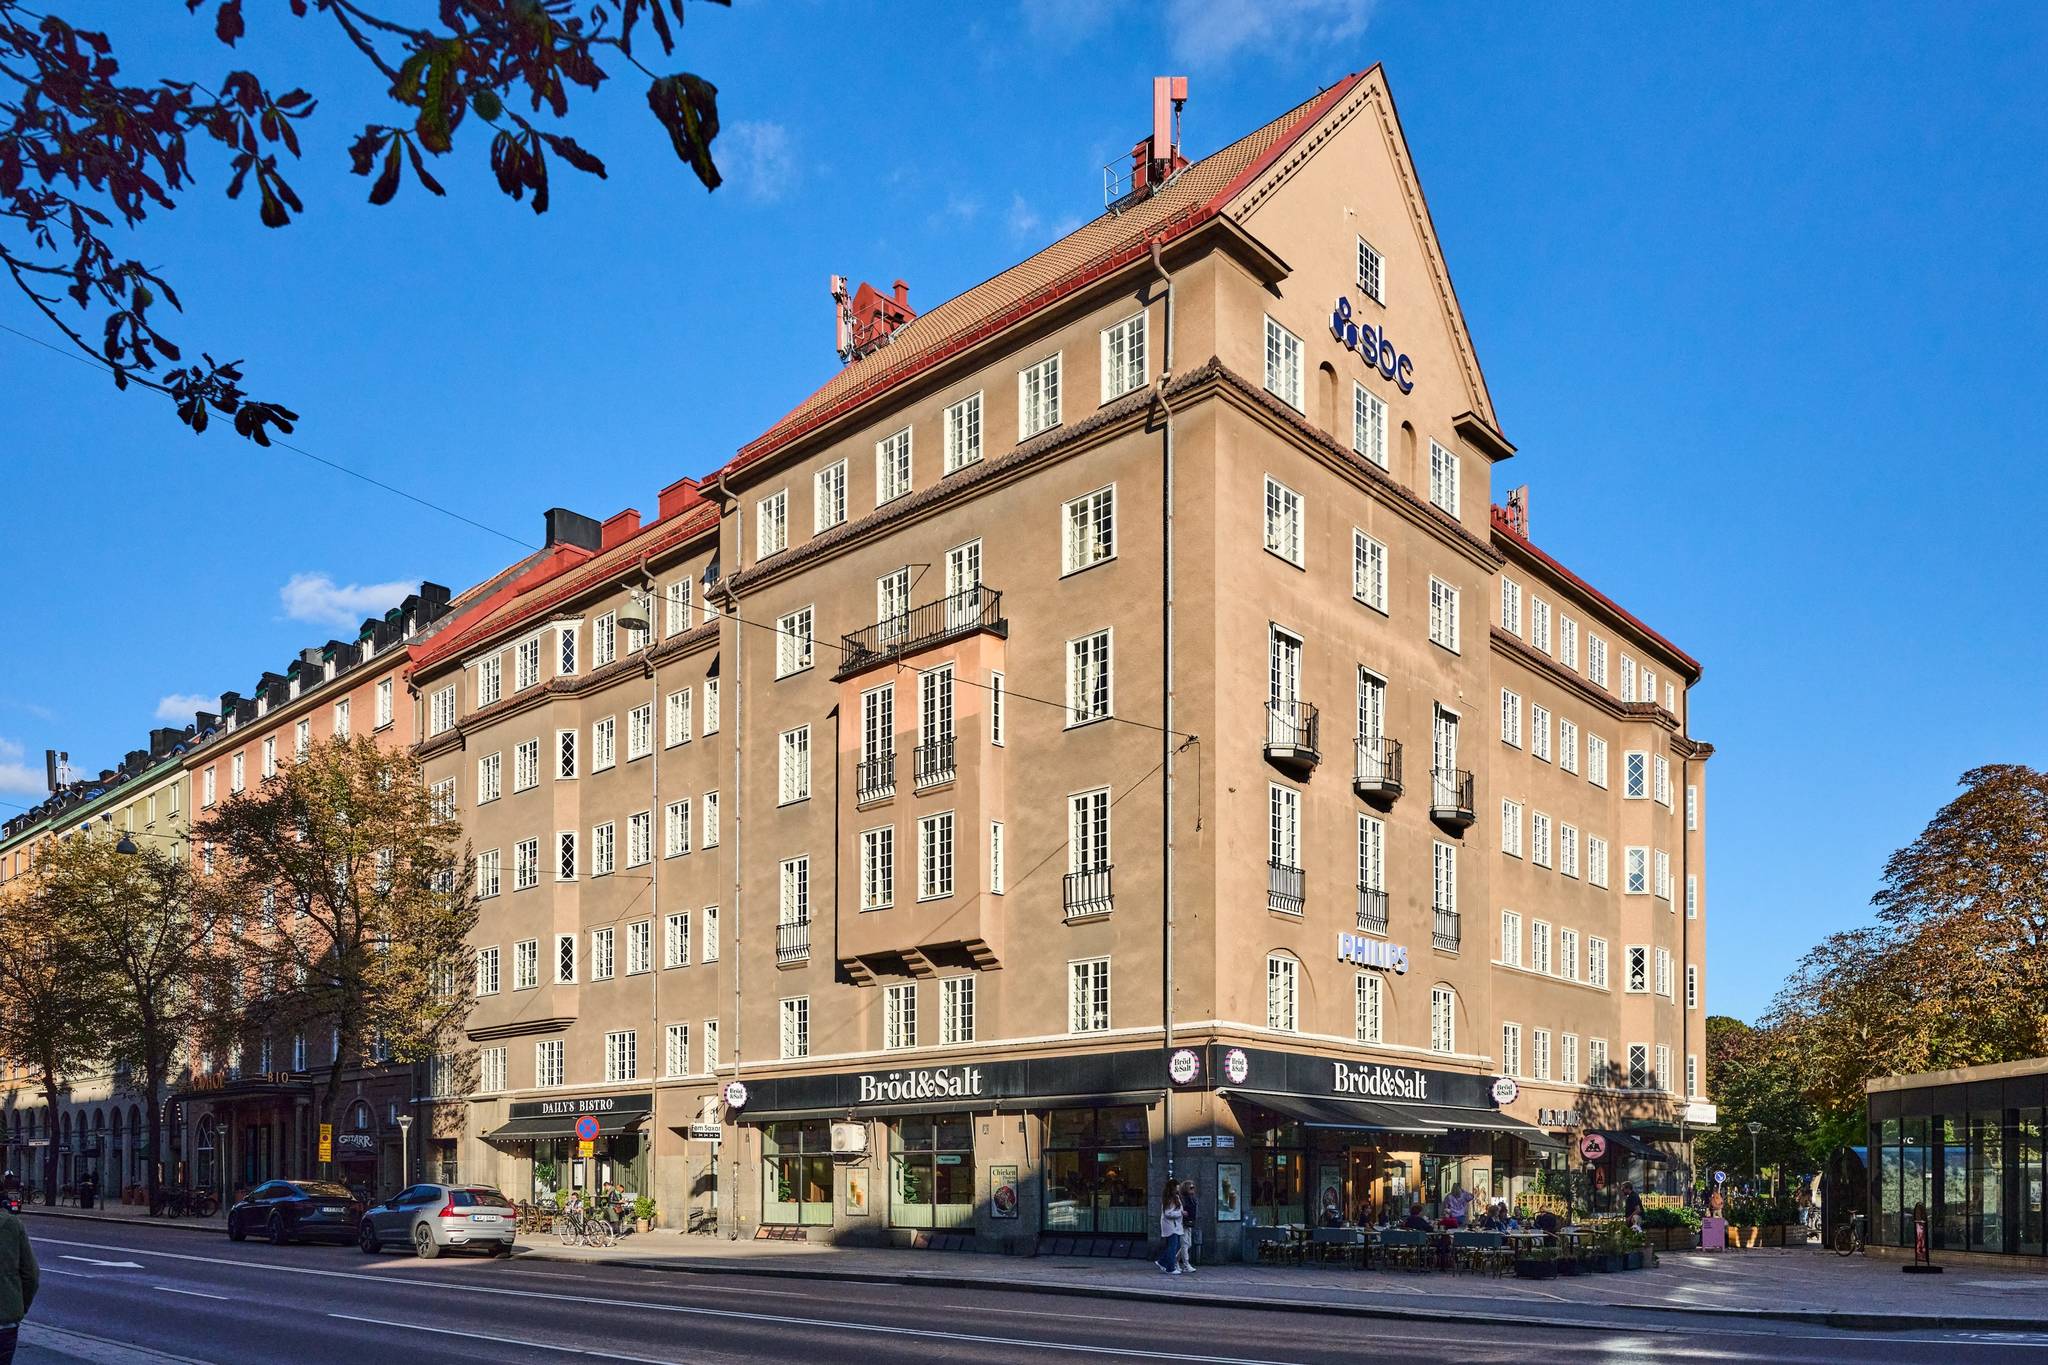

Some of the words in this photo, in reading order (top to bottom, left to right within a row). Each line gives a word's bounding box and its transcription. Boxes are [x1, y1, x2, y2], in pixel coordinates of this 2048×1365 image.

[1359, 323, 1414, 394] sbc
[1337, 931, 1409, 974] PHILIPS
[1174, 1057, 1191, 1066] Bröd
[1174, 1065, 1192, 1073] &Salt
[267, 1071, 289, 1084] BIO
[858, 1066, 983, 1103] Bröd&Salt
[1333, 1062, 1428, 1100] Bröd&Salt
[541, 1101, 575, 1114] DAILY'S
[579, 1098, 614, 1112] BISTRO
[704, 1124, 721, 1132] Saxar
[338, 1134, 373, 1148] GITARR
[992, 1168, 1016, 1176] Chicken
